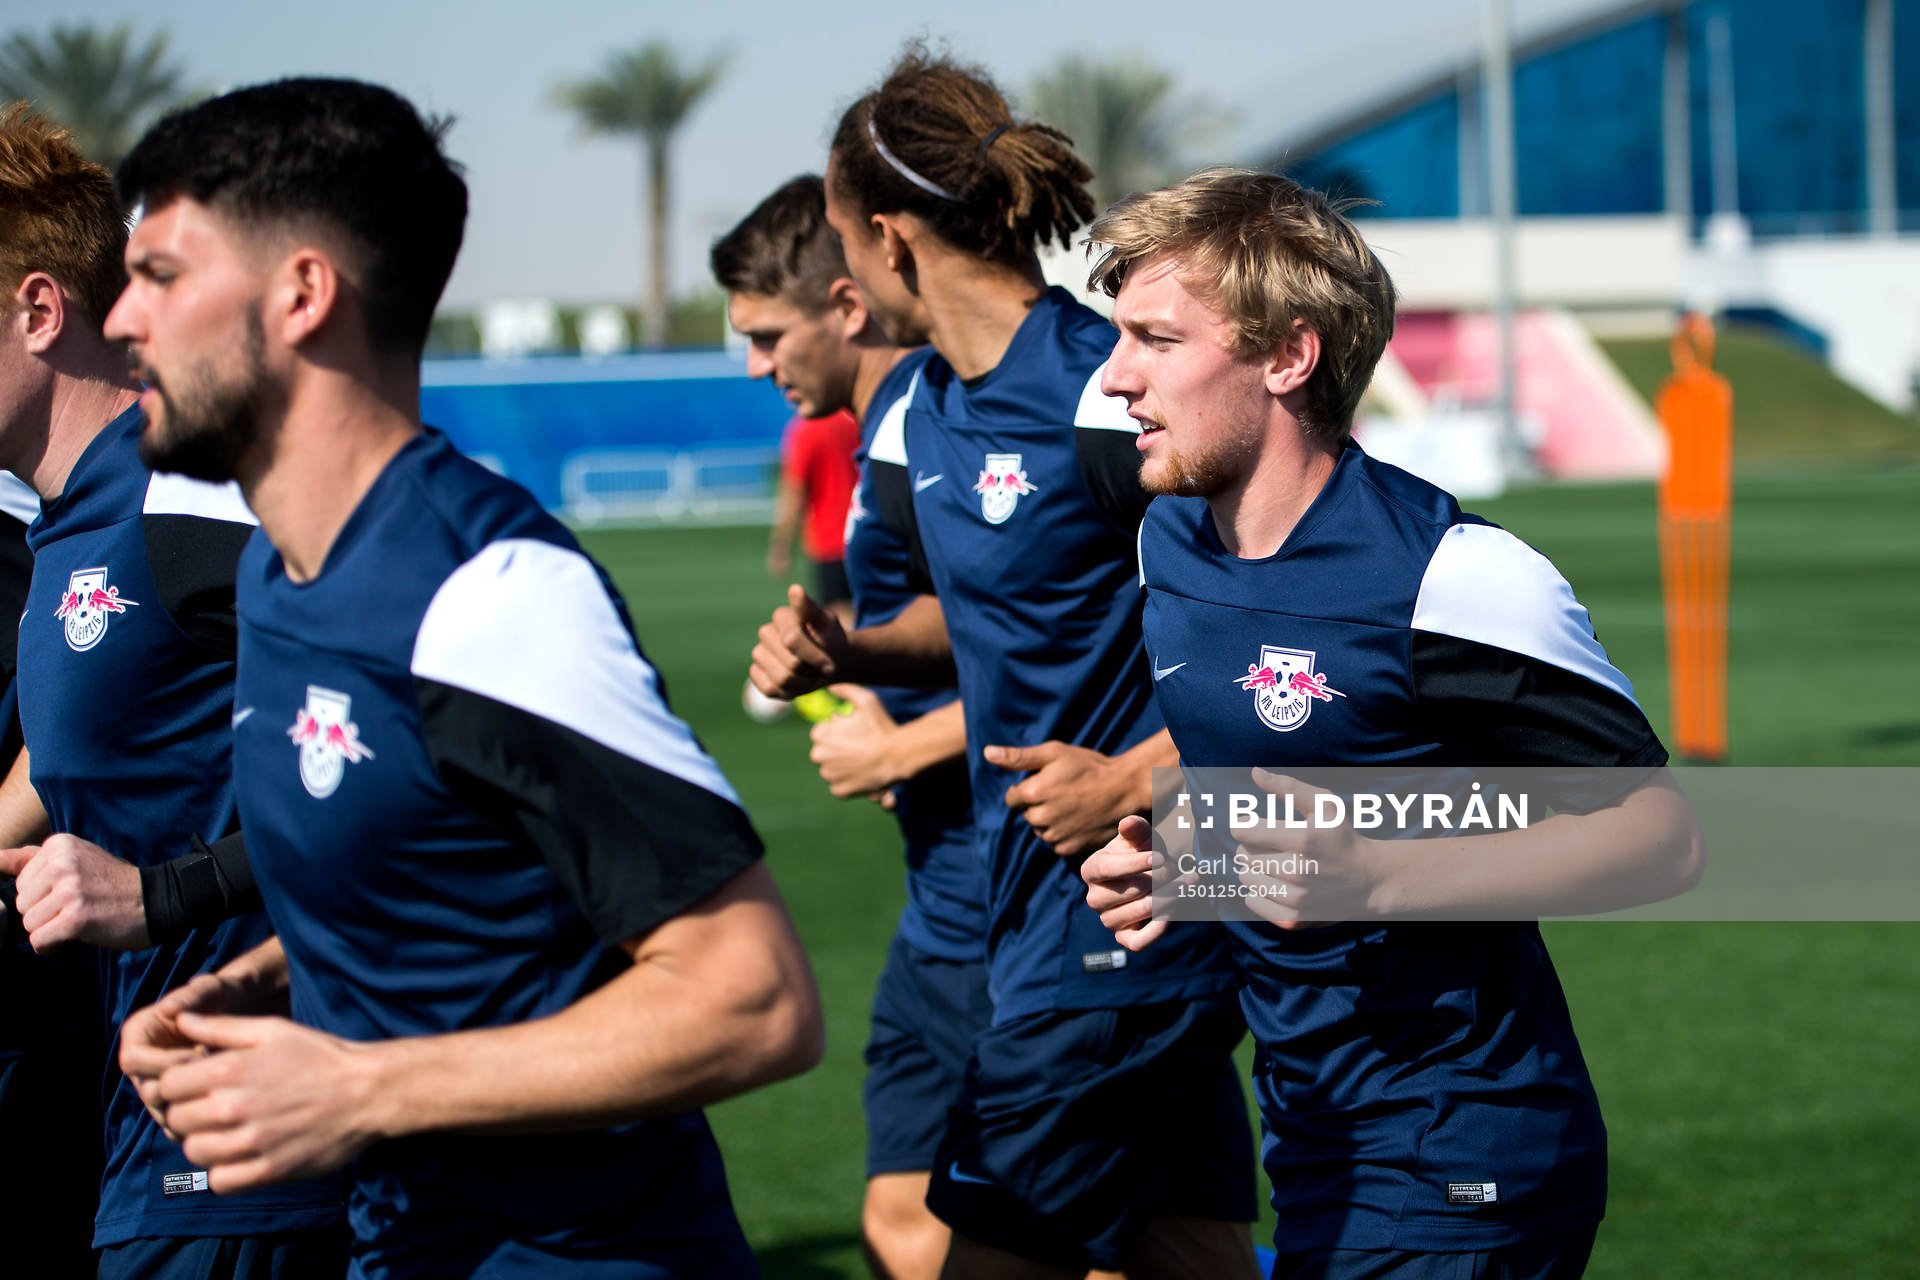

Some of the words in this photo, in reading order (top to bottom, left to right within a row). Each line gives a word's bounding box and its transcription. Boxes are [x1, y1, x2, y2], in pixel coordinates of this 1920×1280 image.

[75, 616, 101, 640] LEIPZIG
[1261, 695, 1272, 710] RB
[1272, 699, 1304, 720] LEIPZIG
